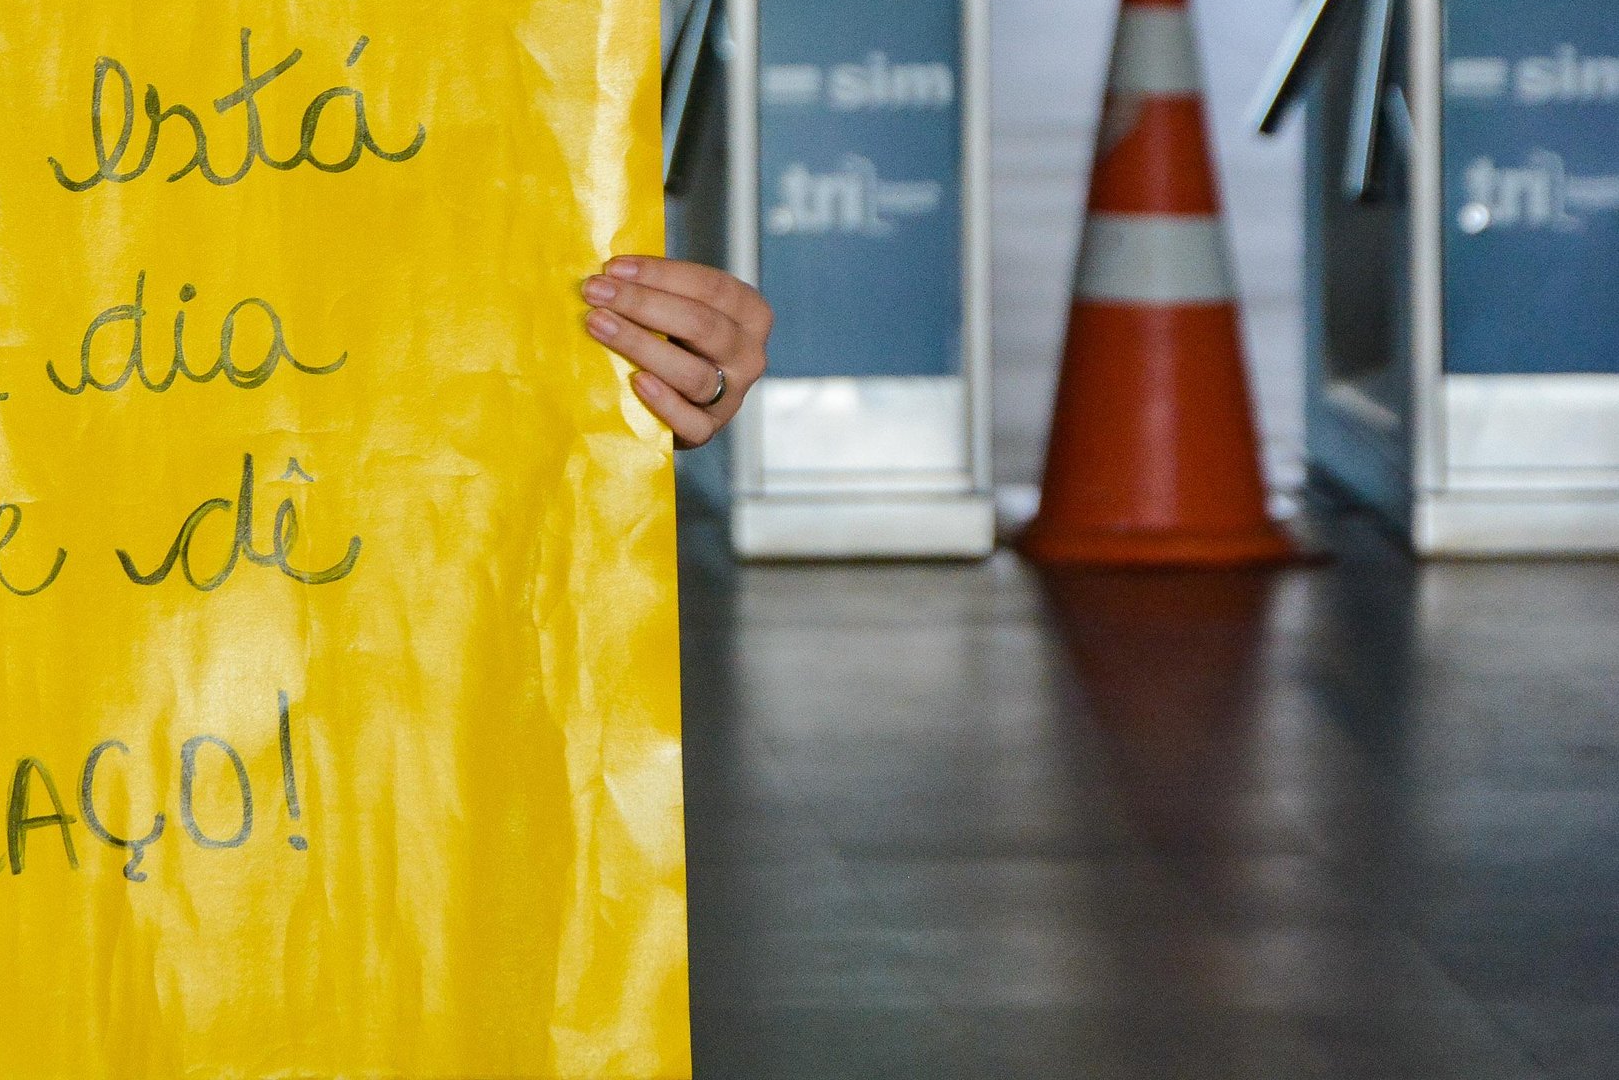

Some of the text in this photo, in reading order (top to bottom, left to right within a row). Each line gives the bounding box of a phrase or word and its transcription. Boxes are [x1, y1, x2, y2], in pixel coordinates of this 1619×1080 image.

[46, 26, 427, 193] está
[831, 51, 956, 108] sim
[45, 268, 349, 396] dia
[115, 451, 363, 593] dê
